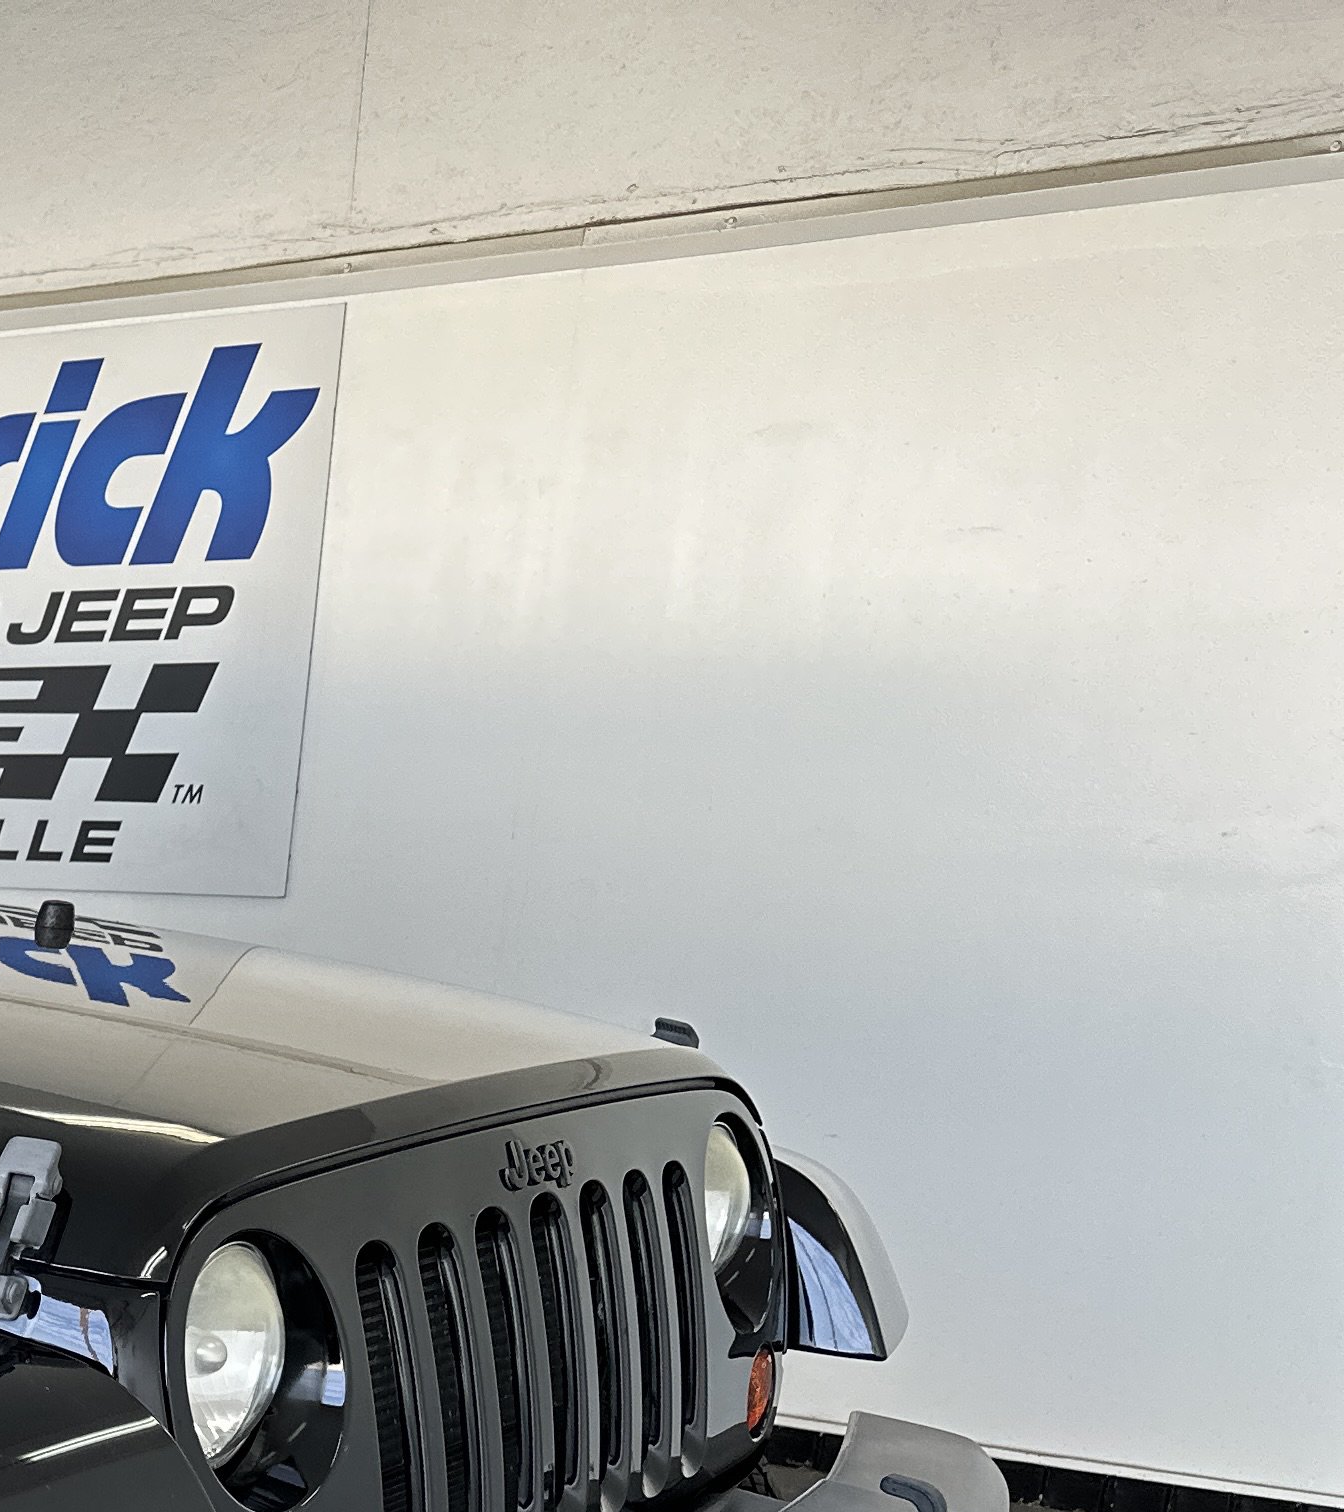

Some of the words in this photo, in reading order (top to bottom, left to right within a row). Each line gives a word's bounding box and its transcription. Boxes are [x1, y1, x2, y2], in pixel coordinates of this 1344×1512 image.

[6, 584, 236, 647] JEEP
[172, 783, 204, 804] TM
[498, 1139, 574, 1191] Jeep
